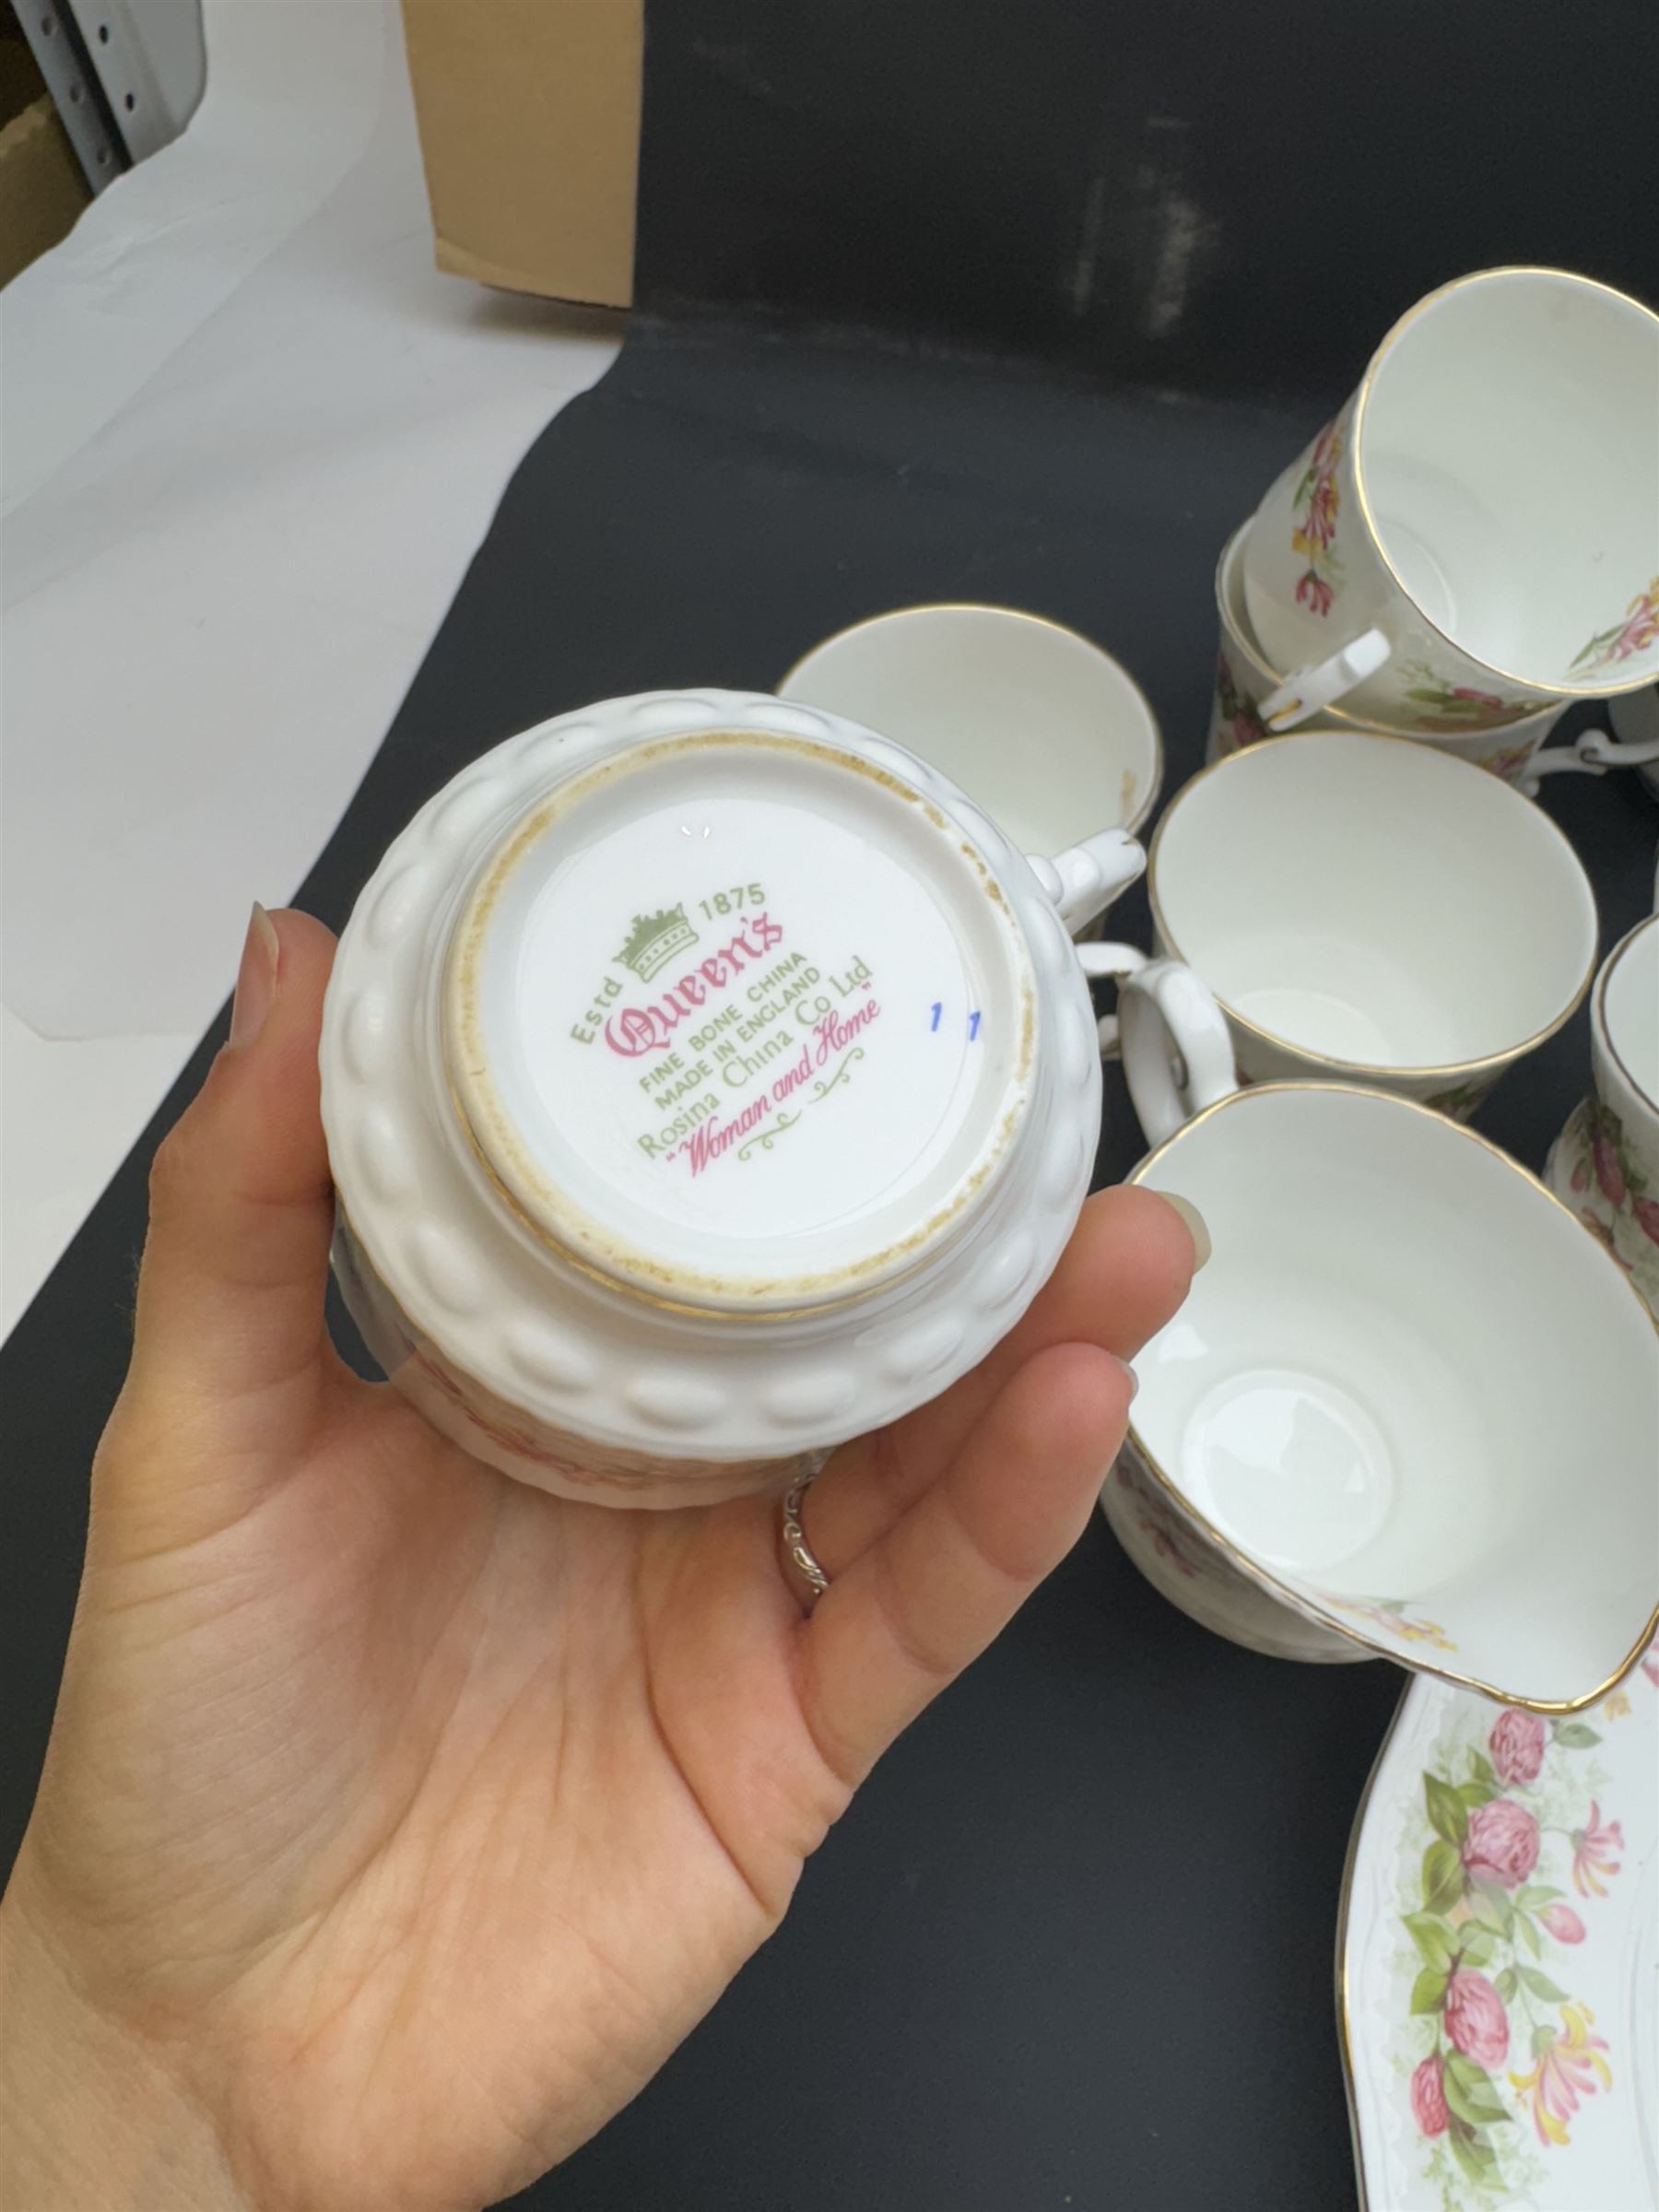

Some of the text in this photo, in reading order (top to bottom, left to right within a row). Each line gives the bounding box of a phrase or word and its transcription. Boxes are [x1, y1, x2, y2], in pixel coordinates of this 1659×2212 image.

[570, 883, 766, 1046] Estd 1875
[605, 912, 783, 1058] Queen's
[639, 951, 807, 1094] FINE BONE CHINA
[637, 955, 874, 1159] Rosina China Co Ltd
[654, 966, 822, 1111] MADE IN ENGLAND
[771, 1044, 815, 1102] and
